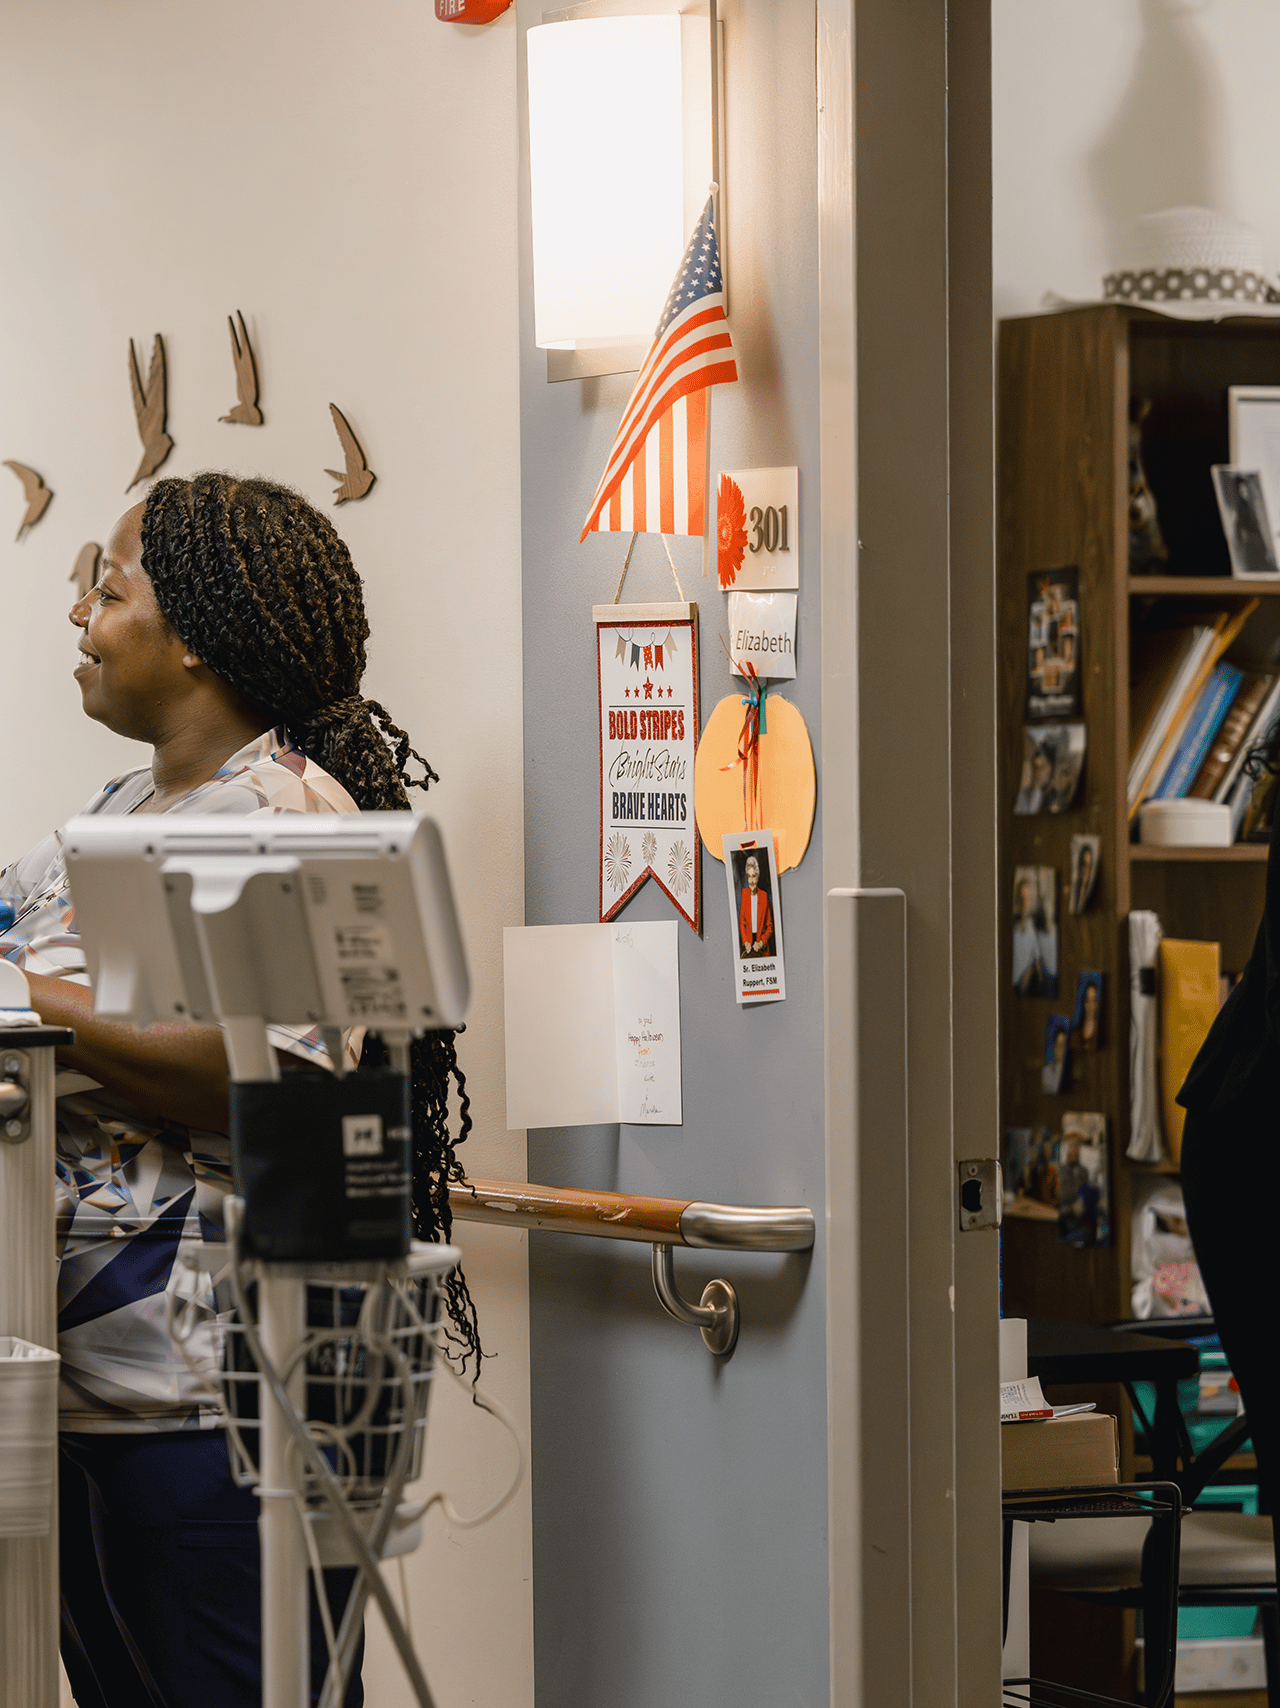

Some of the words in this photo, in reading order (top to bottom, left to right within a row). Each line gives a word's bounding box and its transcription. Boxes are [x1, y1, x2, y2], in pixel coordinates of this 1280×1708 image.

[439, 0, 466, 16] FIRE
[748, 504, 790, 553] 301
[735, 629, 792, 654] Elizabeth
[608, 710, 638, 741] BOLD
[639, 709, 685, 741] STRIPES
[612, 791, 646, 820] BRAVE
[647, 792, 687, 821] HEARTS
[742, 964, 751, 974] Sr.
[751, 962, 776, 973] Elizabeth
